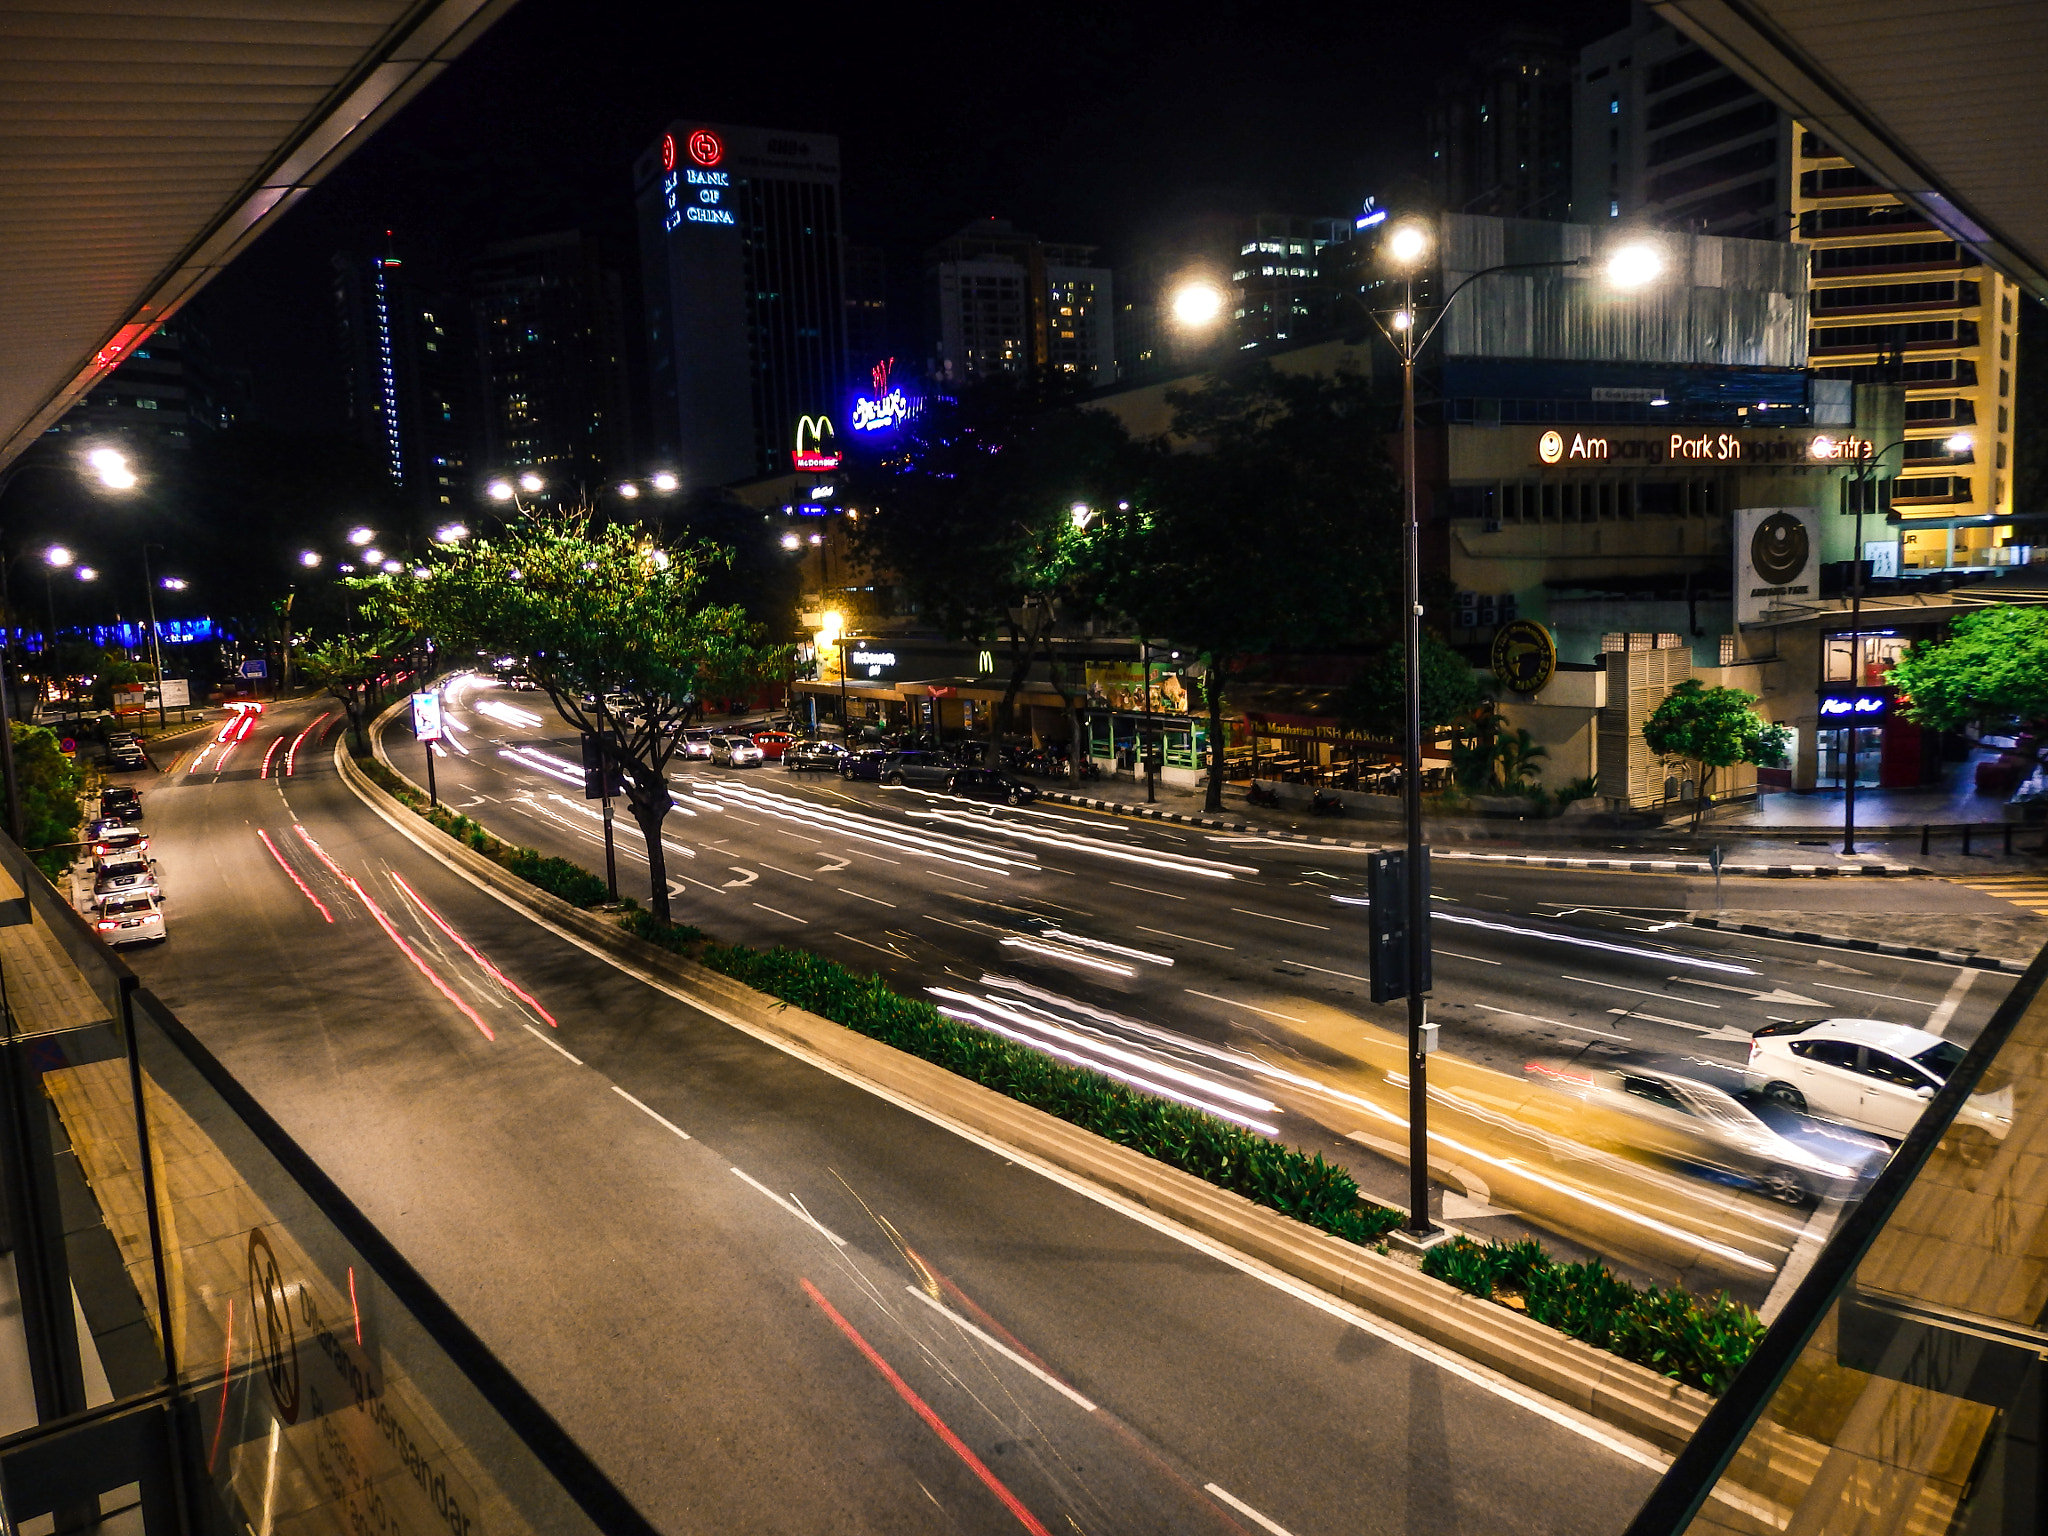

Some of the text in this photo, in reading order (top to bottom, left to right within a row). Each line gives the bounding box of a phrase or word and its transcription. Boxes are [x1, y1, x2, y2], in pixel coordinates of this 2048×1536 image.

[686, 169, 729, 186] BANK
[700, 189, 720, 204] OF
[687, 206, 734, 224] CHINA
[1569, 432, 1664, 464] Ampang
[1670, 433, 1713, 459] Park
[1266, 721, 1314, 736] Manhattan
[1316, 726, 1341, 738] FISH
[366, 1371, 471, 1536] bersandar
